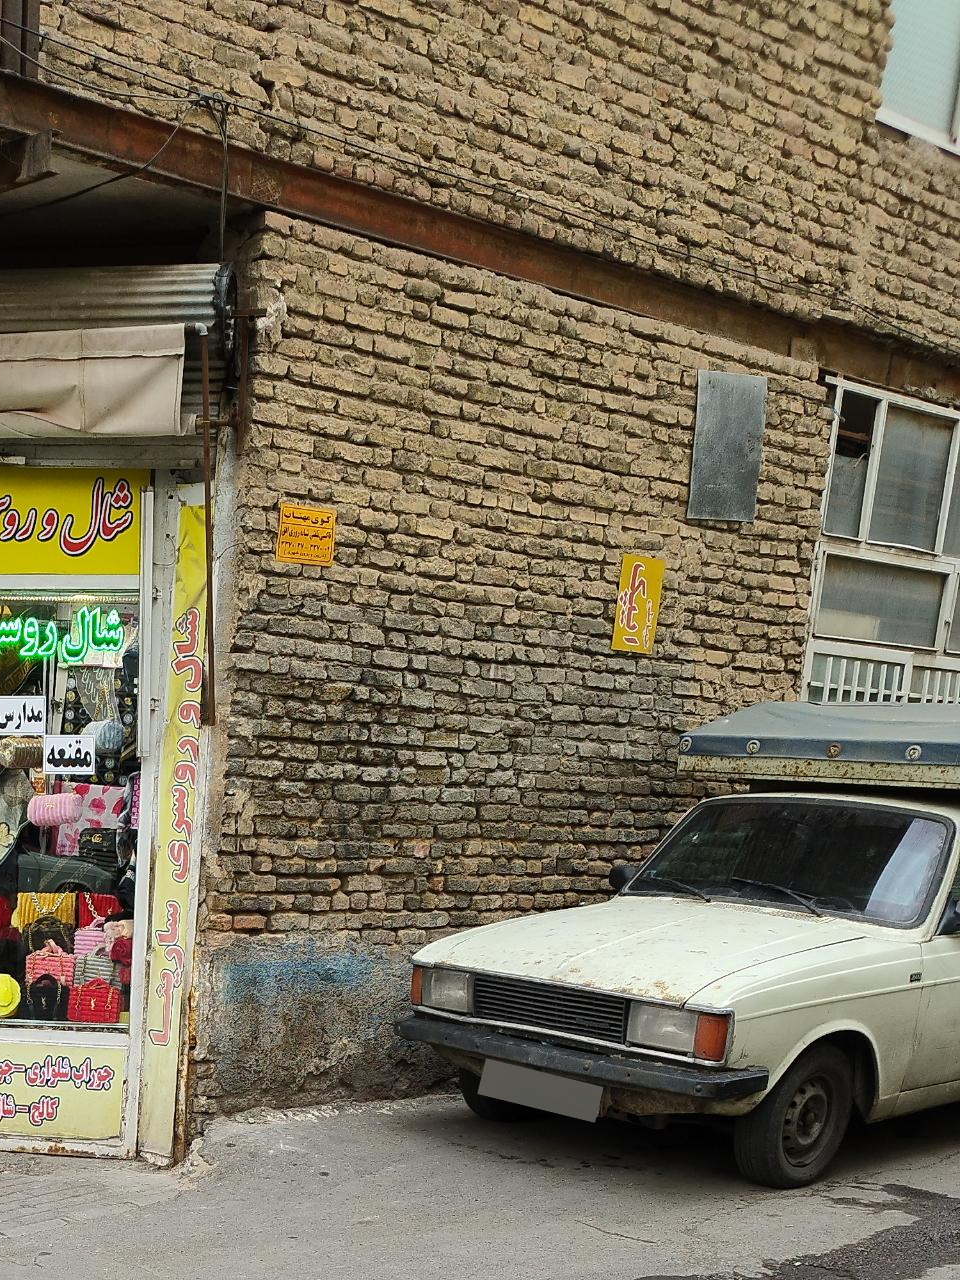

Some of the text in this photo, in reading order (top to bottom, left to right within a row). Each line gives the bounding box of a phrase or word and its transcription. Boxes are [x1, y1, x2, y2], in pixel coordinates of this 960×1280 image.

[38, 508, 58, 541] و
[60, 477, 133, 556] شال
[60, 604, 126, 662] شال
[46, 740, 93, 768] مقنعه
[148, 607, 202, 1047] شال و روسری سارینا
[25, 1055, 71, 1086] شلواری
[71, 1056, 115, 1090] جوراب
[28, 1095, 60, 1126] کالج
